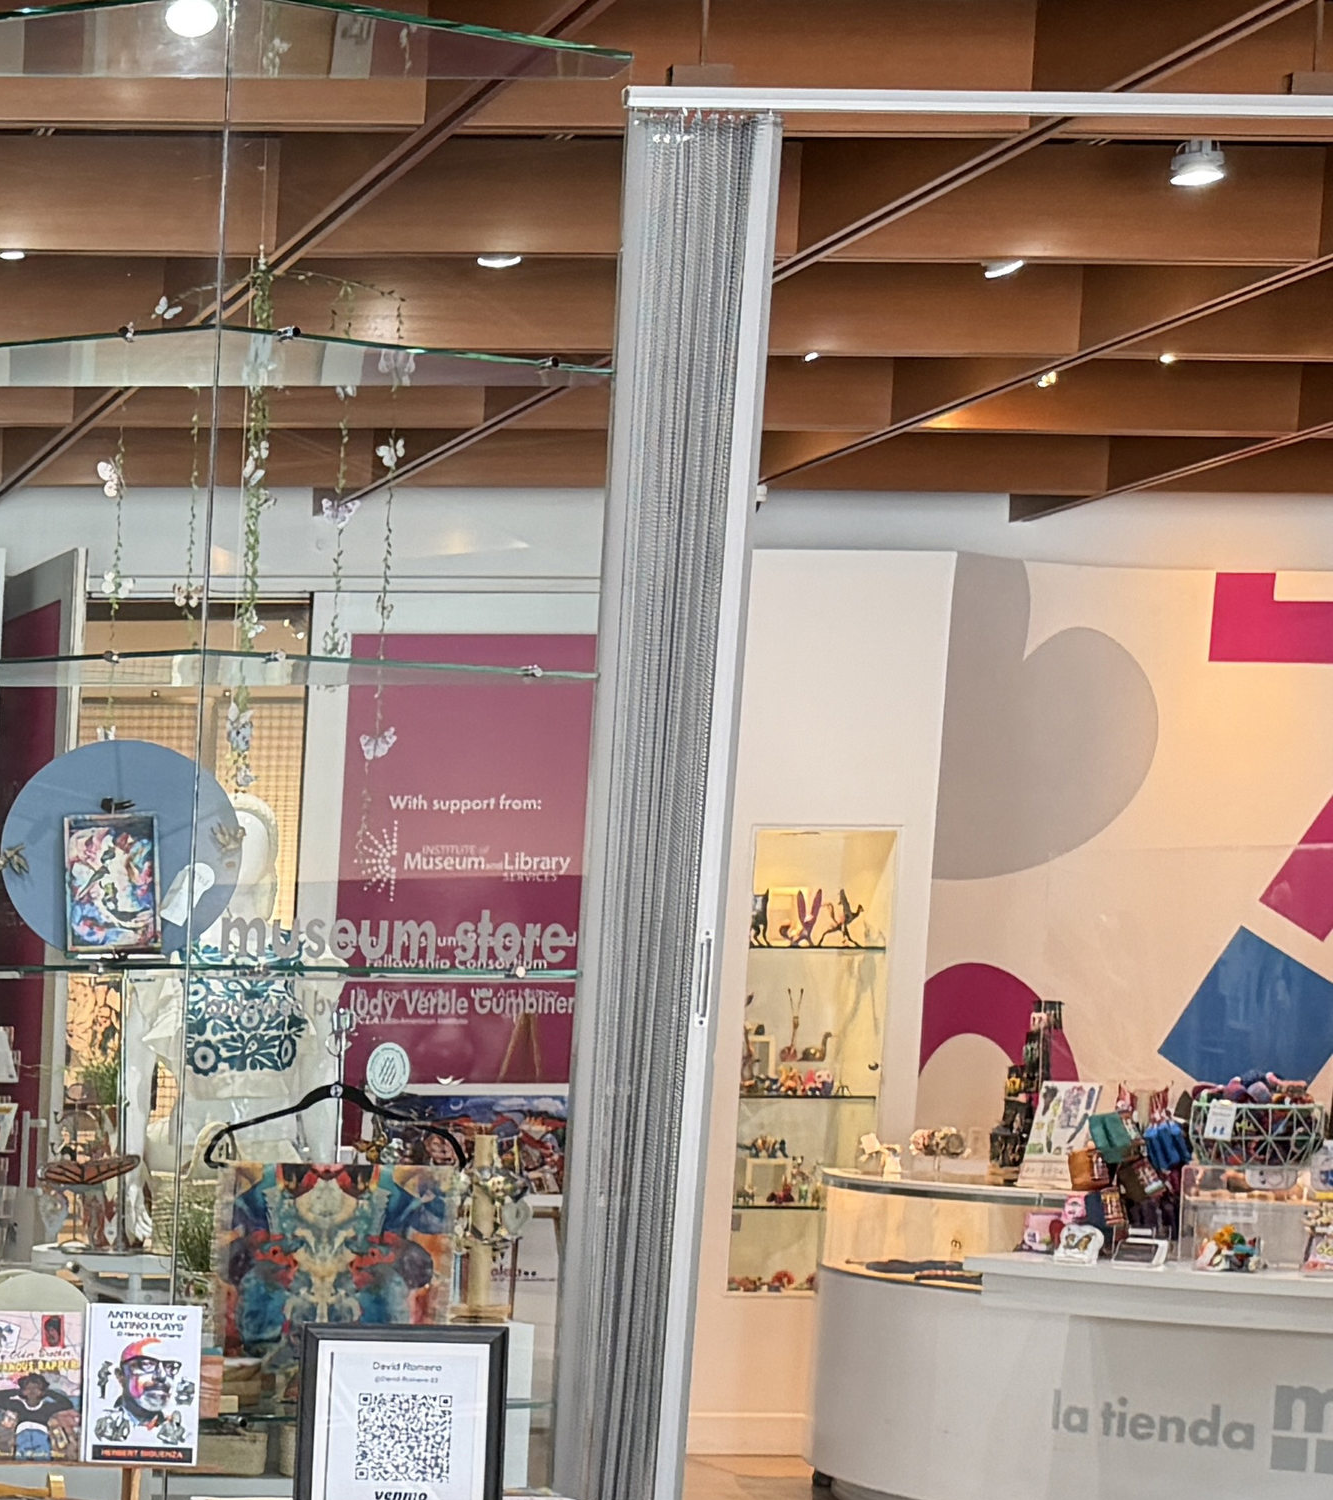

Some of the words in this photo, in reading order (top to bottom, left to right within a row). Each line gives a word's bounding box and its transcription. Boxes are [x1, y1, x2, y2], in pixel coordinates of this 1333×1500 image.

[389, 794, 428, 811] With
[433, 795, 494, 815] support
[499, 794, 543, 812] from:
[422, 844, 476, 855] INSTITUTE
[403, 852, 485, 871] Museum
[504, 852, 571, 875] Library
[502, 871, 558, 882] SERVICES
[221, 914, 437, 961] museum
[454, 909, 567, 963] store
[350, 988, 399, 1020] Judy
[404, 988, 469, 1015] Verble
[474, 988, 576, 1016] Gumbiner
[108, 1310, 174, 1321] ANTHOLOGY
[110, 1321, 148, 1330] LATINO
[151, 1322, 184, 1332] PLAYS
[373, 1361, 400, 1371] David
[403, 1362, 442, 1372] Romero
[1052, 1388, 1089, 1434] la
[1101, 1396, 1255, 1451] tienda
